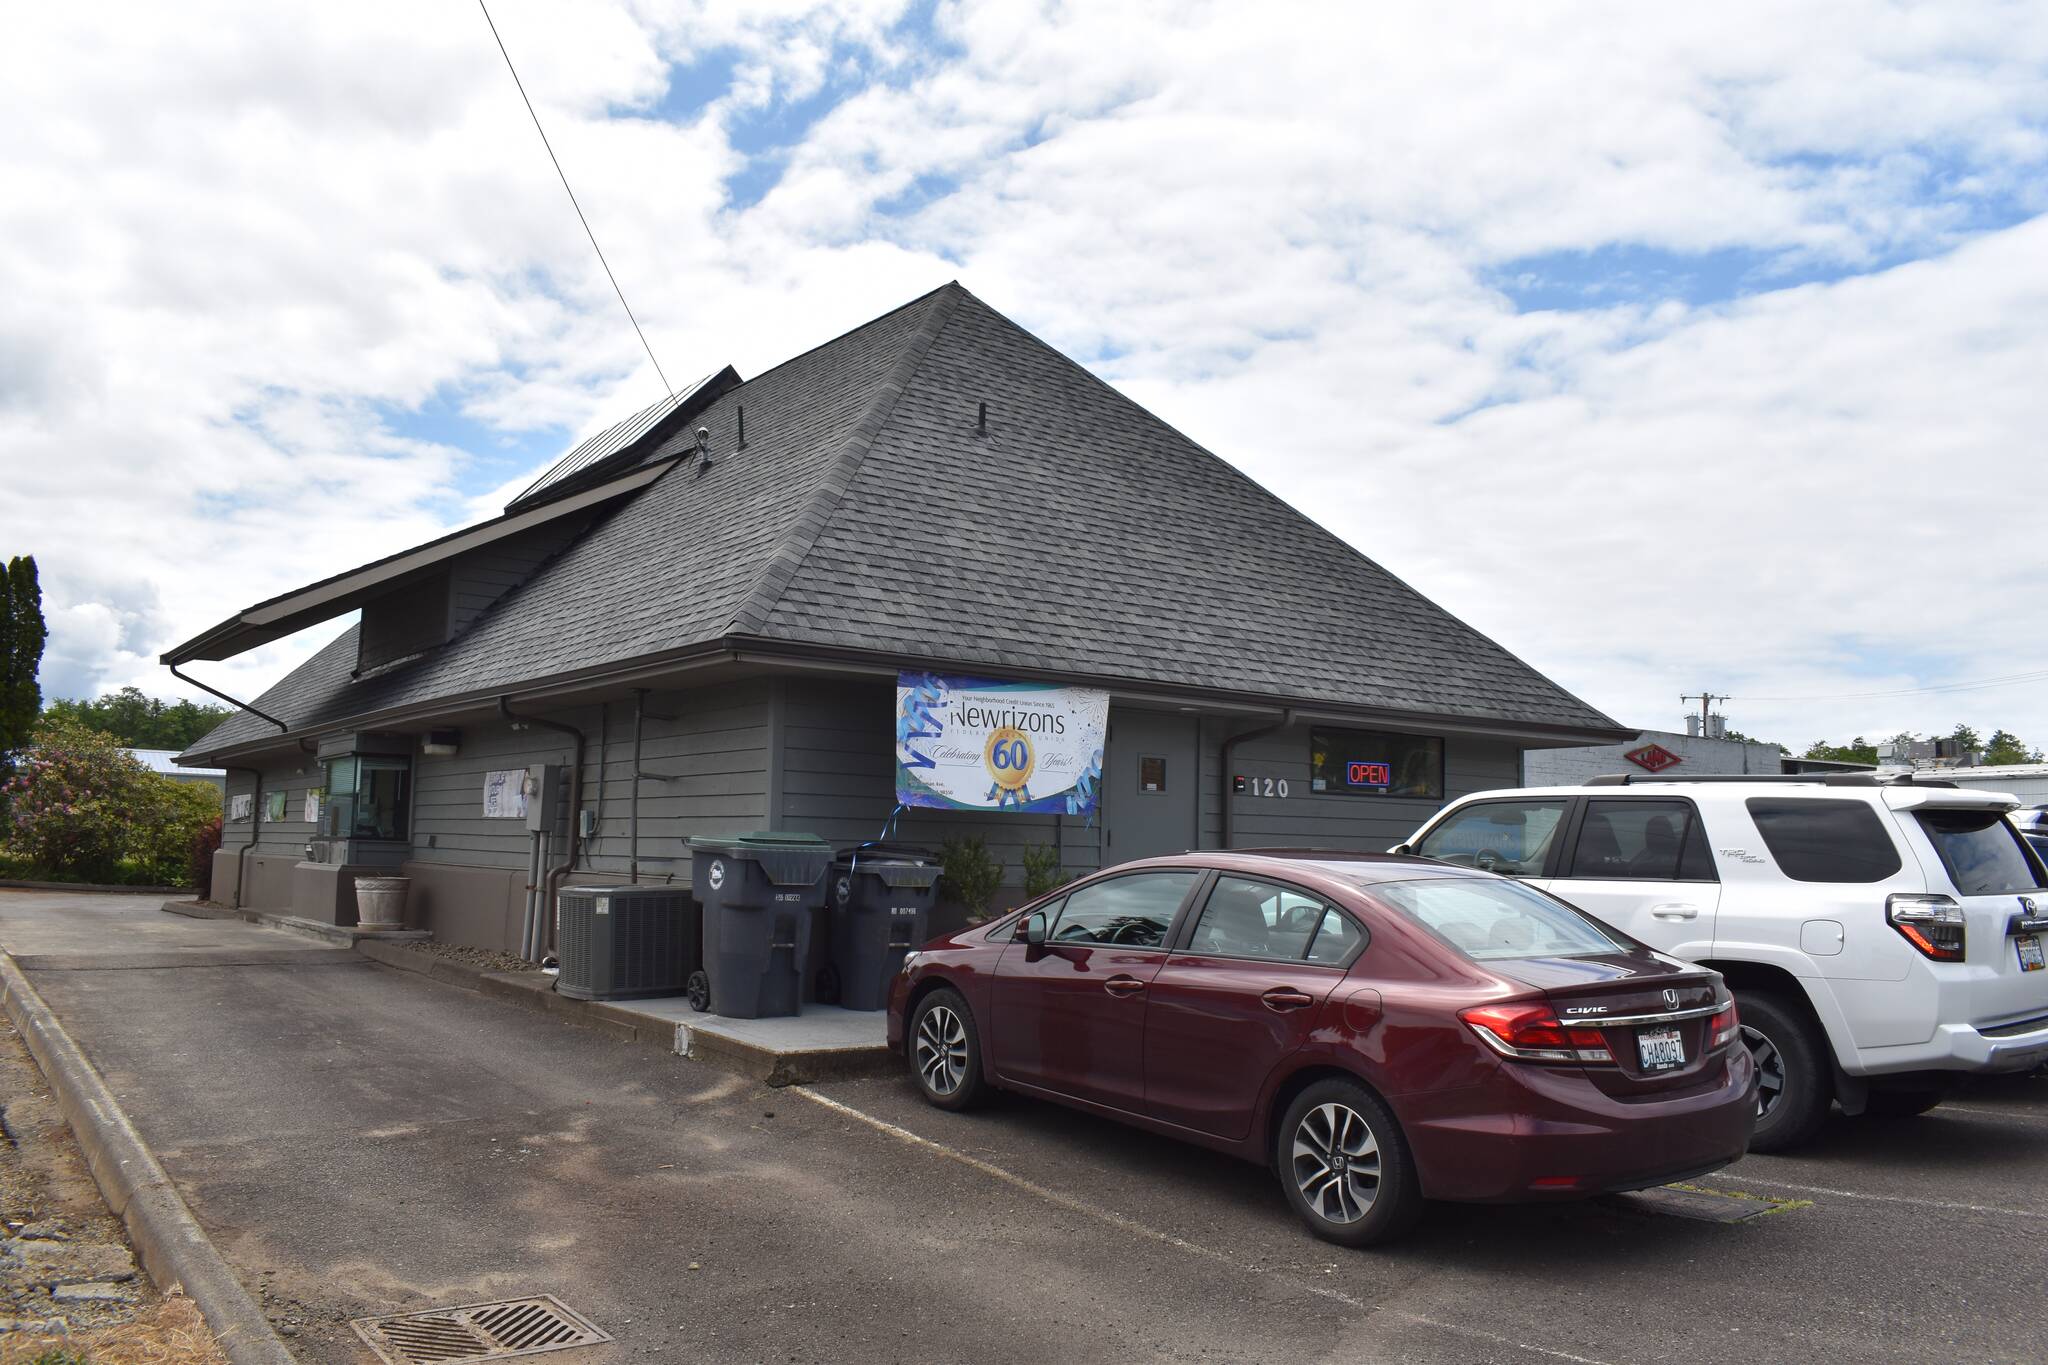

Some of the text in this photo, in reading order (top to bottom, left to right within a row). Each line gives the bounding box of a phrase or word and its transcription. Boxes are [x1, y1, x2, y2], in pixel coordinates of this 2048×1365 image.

[973, 696, 1006, 705] Neighborhood
[950, 700, 1065, 735] Newrizons
[929, 744, 981, 765] Celebrating
[992, 738, 1028, 770] 60
[1350, 764, 1388, 784] OPEN
[1252, 777, 1289, 798] 120
[1566, 1006, 1608, 1014] CIVIC
[1641, 1039, 1684, 1067] CHA8097
